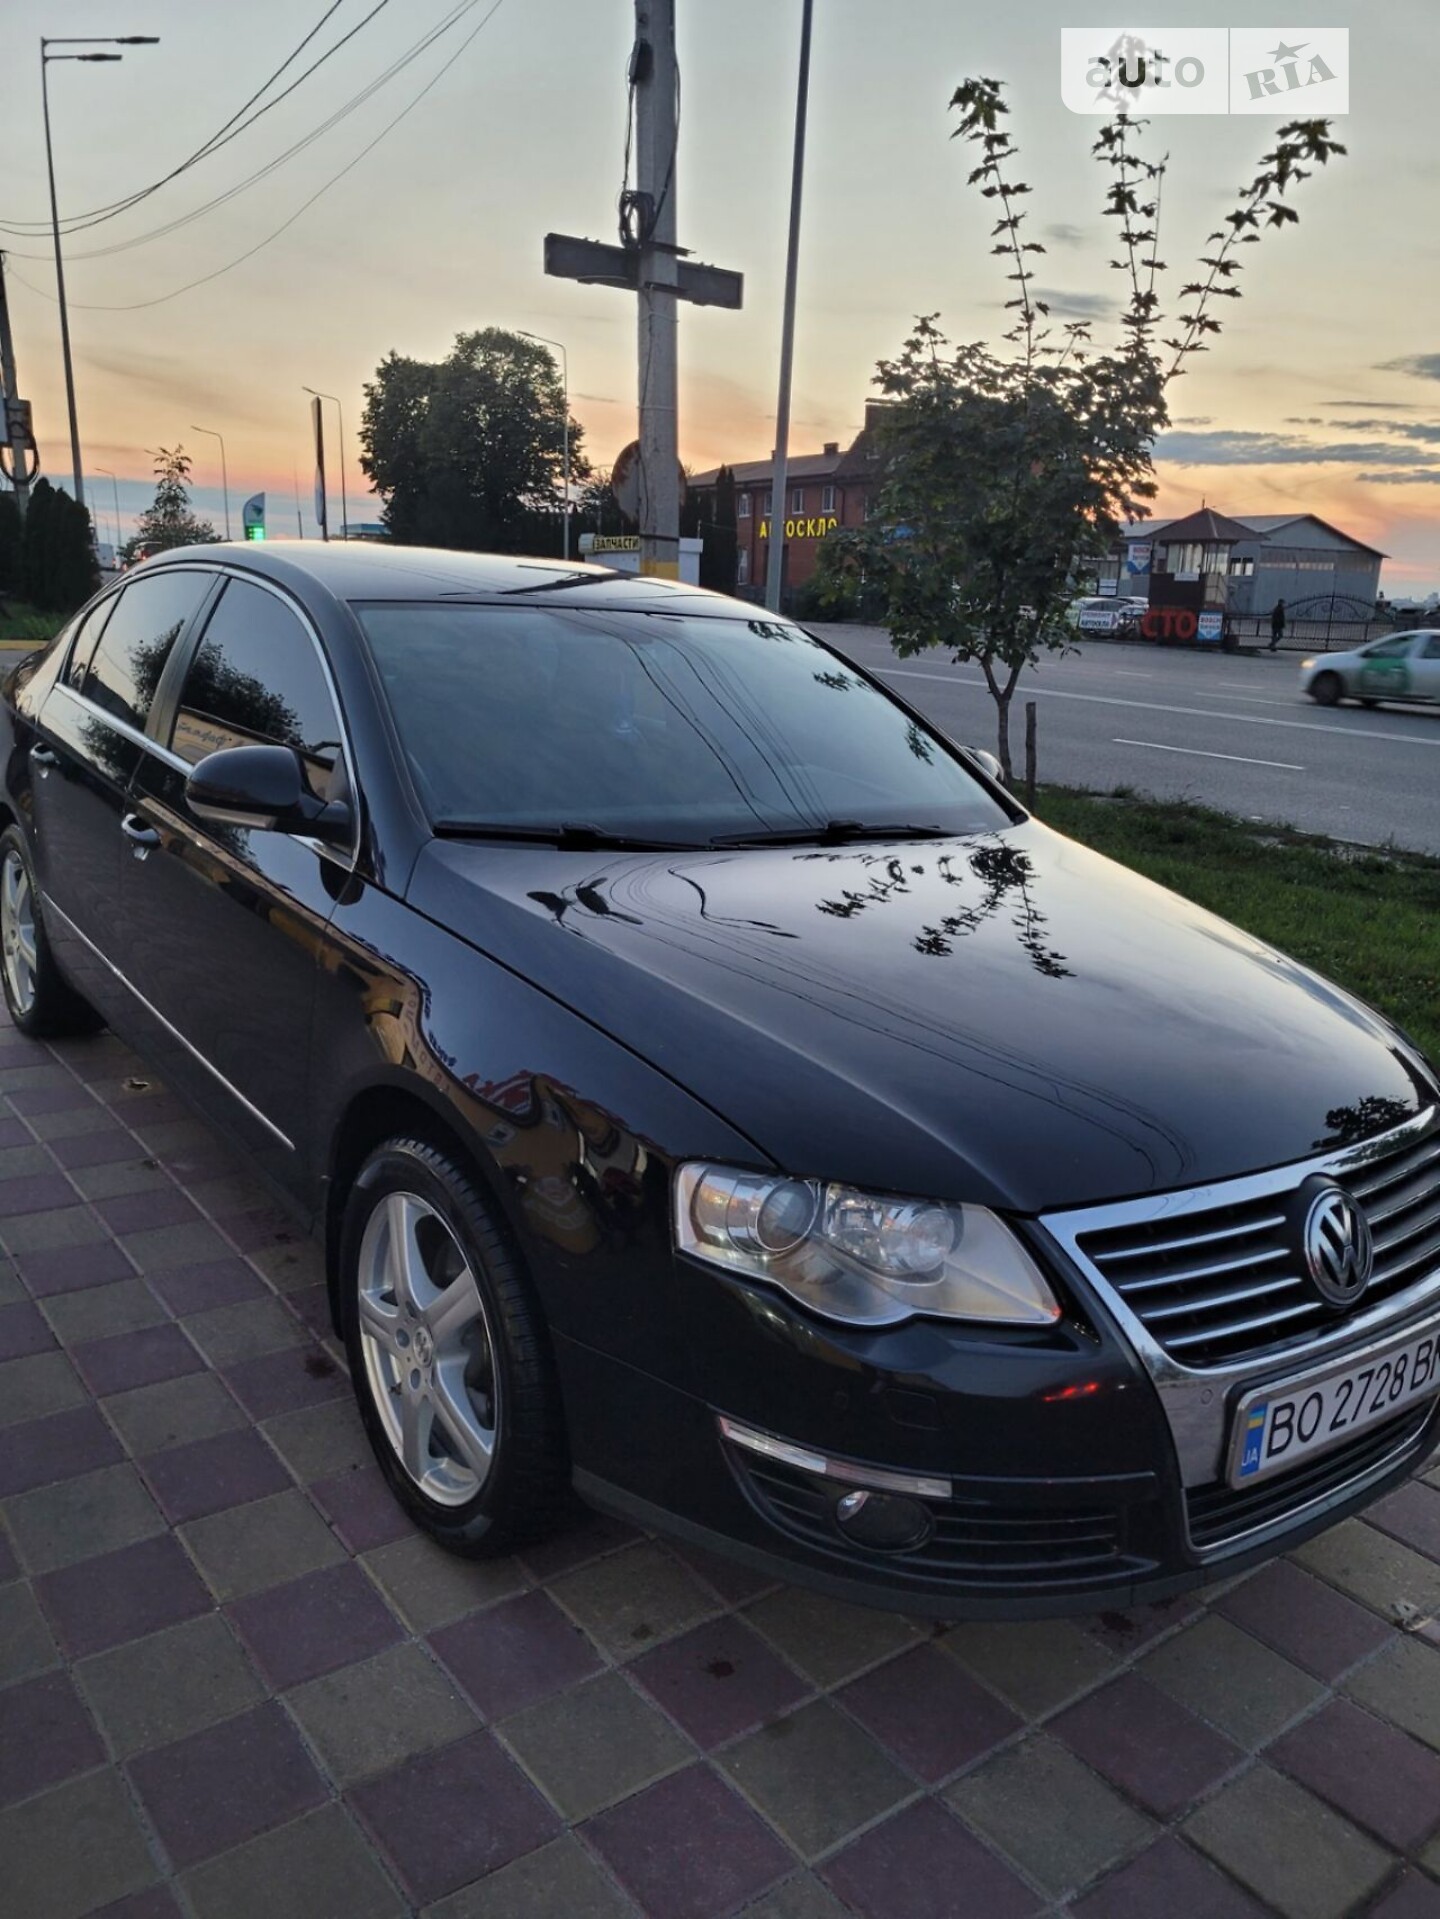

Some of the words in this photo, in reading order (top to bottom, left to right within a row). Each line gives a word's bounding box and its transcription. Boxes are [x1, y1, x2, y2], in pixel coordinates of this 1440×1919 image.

[595, 537, 639, 550] ЗАПЧАСТИ
[1141, 607, 1197, 639] СТО
[1266, 1392, 1323, 1459] BO
[1329, 1353, 1408, 1432] 2728
